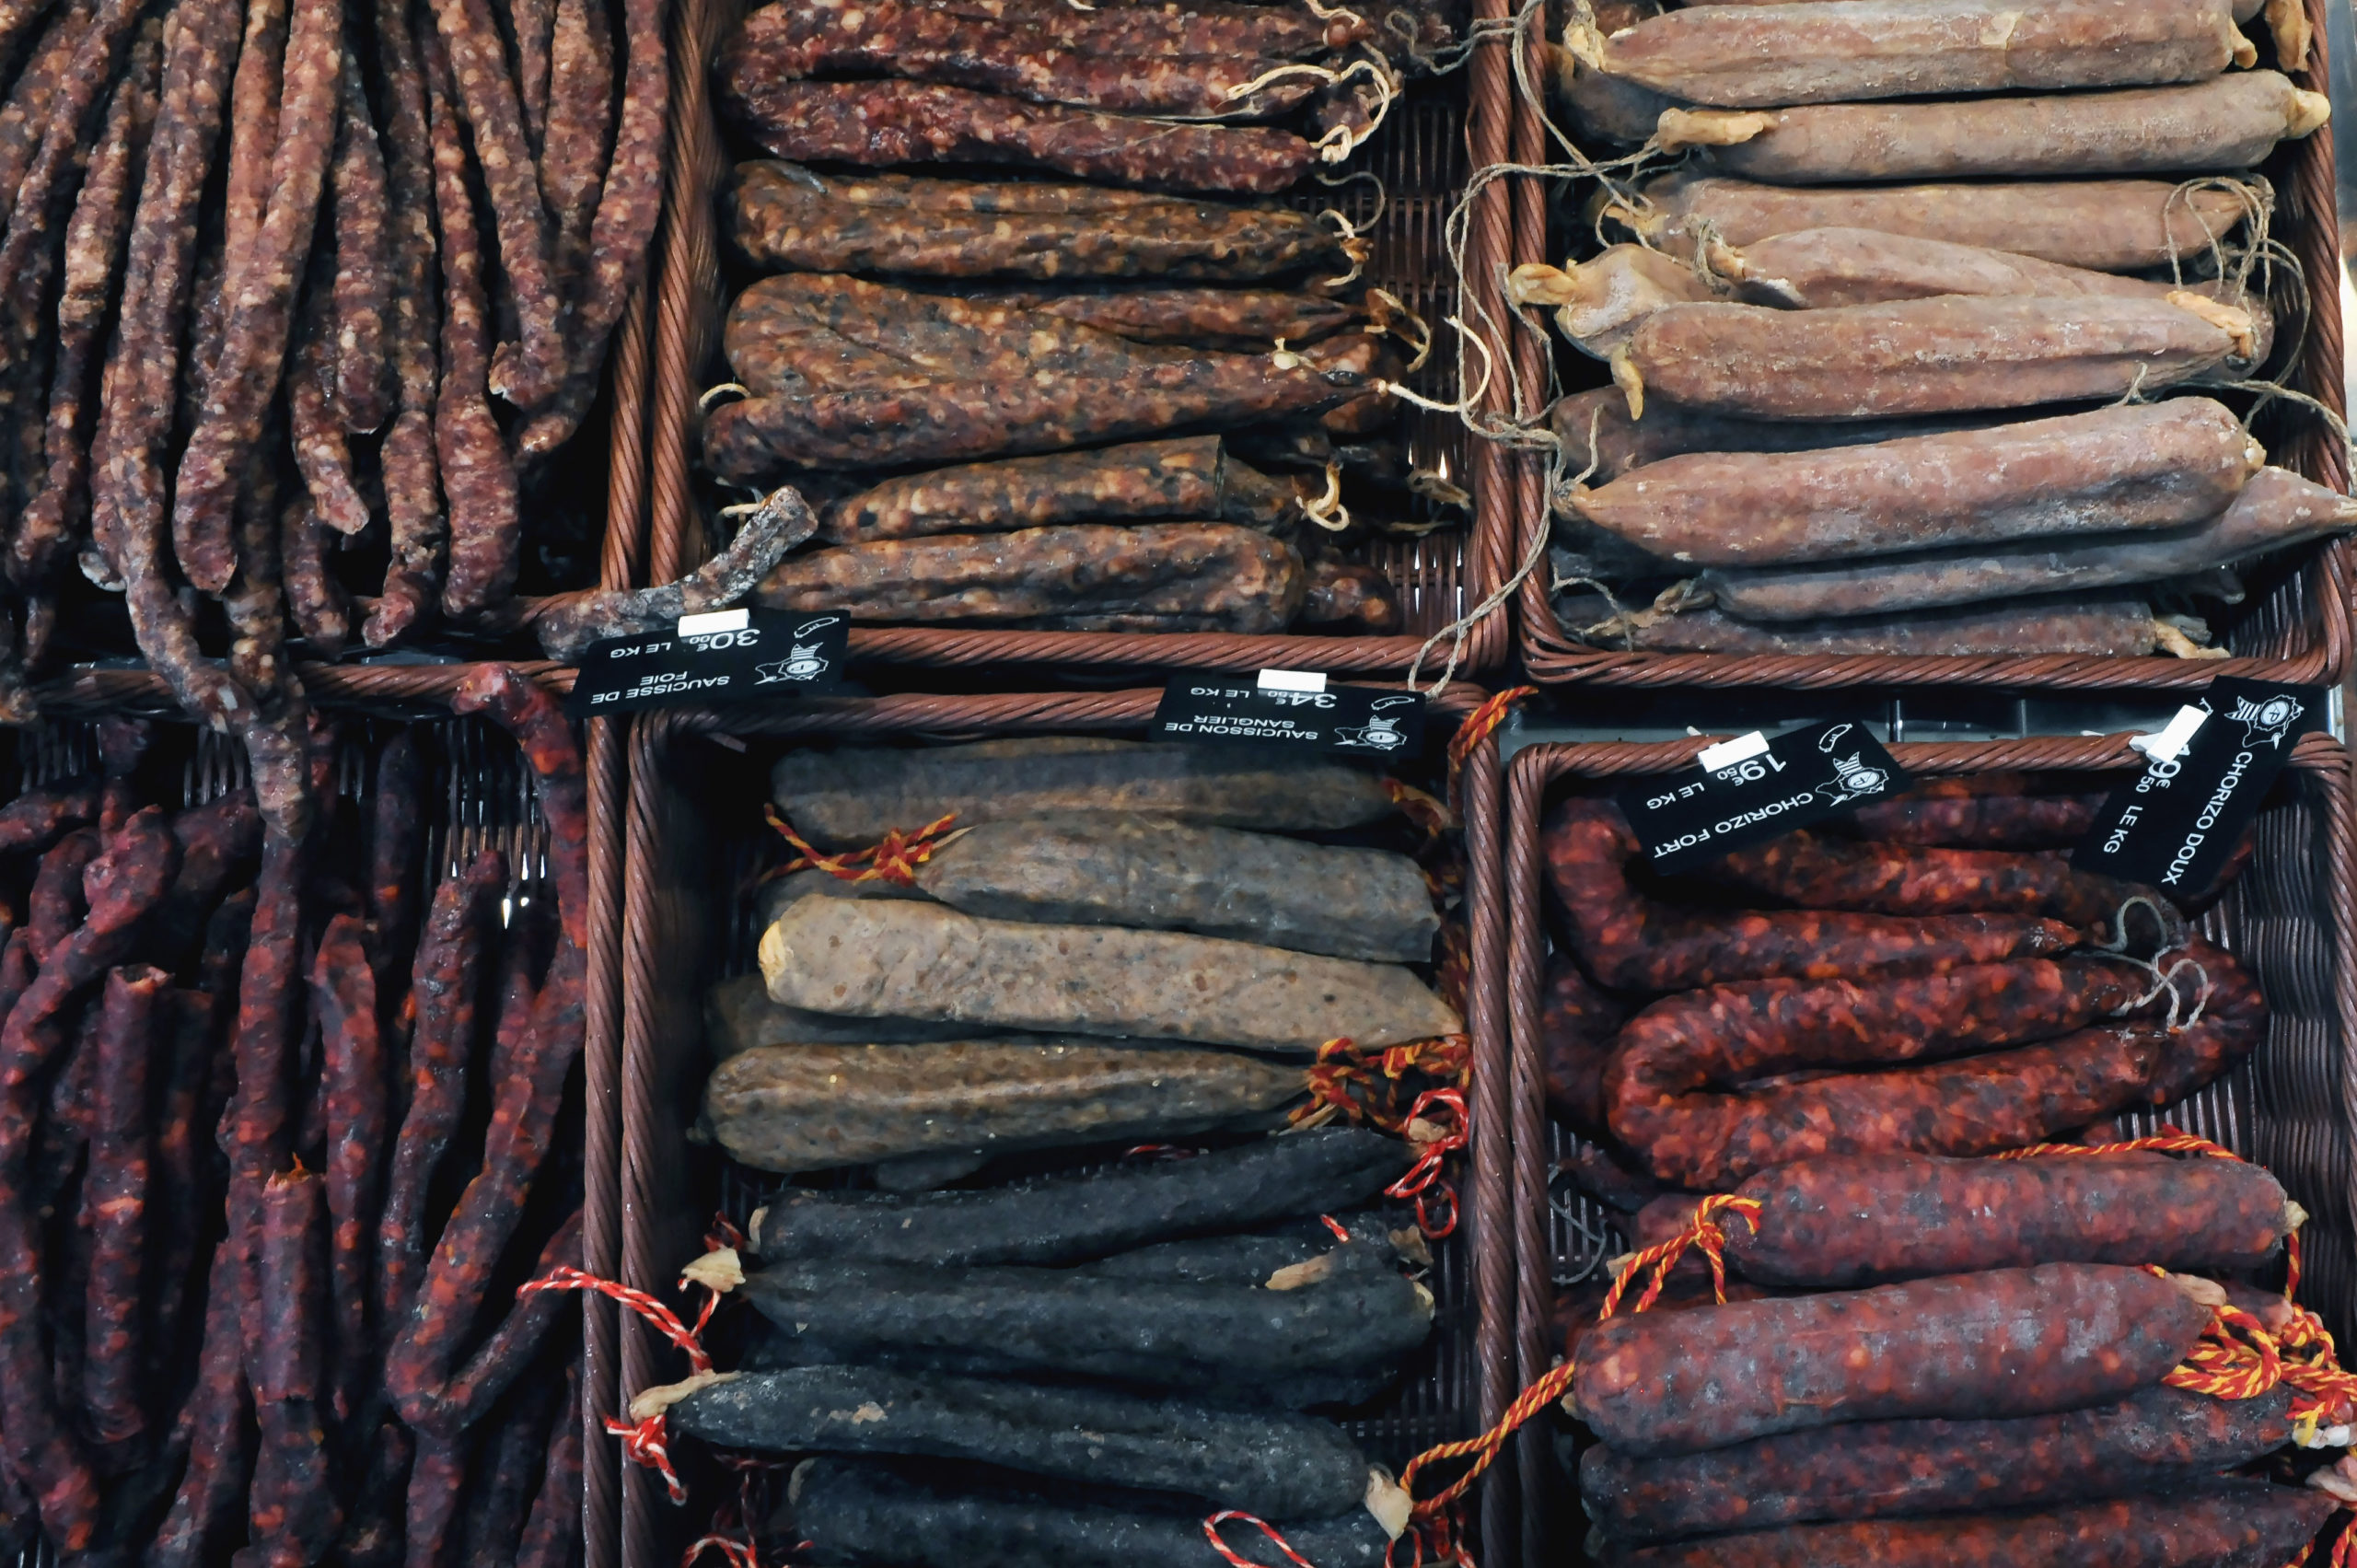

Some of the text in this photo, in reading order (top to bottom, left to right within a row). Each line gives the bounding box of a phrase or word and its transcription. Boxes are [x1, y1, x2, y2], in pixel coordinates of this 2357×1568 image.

[610, 646, 639, 658] KG
[645, 642, 671, 654] LE
[640, 670, 688, 686] FOIE
[591, 675, 730, 704] SAUCISSE DE
[1190, 687, 1220, 697] KG
[1225, 689, 1249, 699] LE
[1193, 714, 1295, 729] SANGLIER
[1165, 722, 1318, 740] SAUCISSON DE
[1678, 782, 1704, 798] LE
[1646, 792, 1677, 809] KG
[2119, 805, 2142, 827] LE
[2162, 751, 2253, 886] CHORIZO DOUX
[1654, 792, 1814, 859] CHORIZO FORT
[2103, 829, 2129, 854] KG
